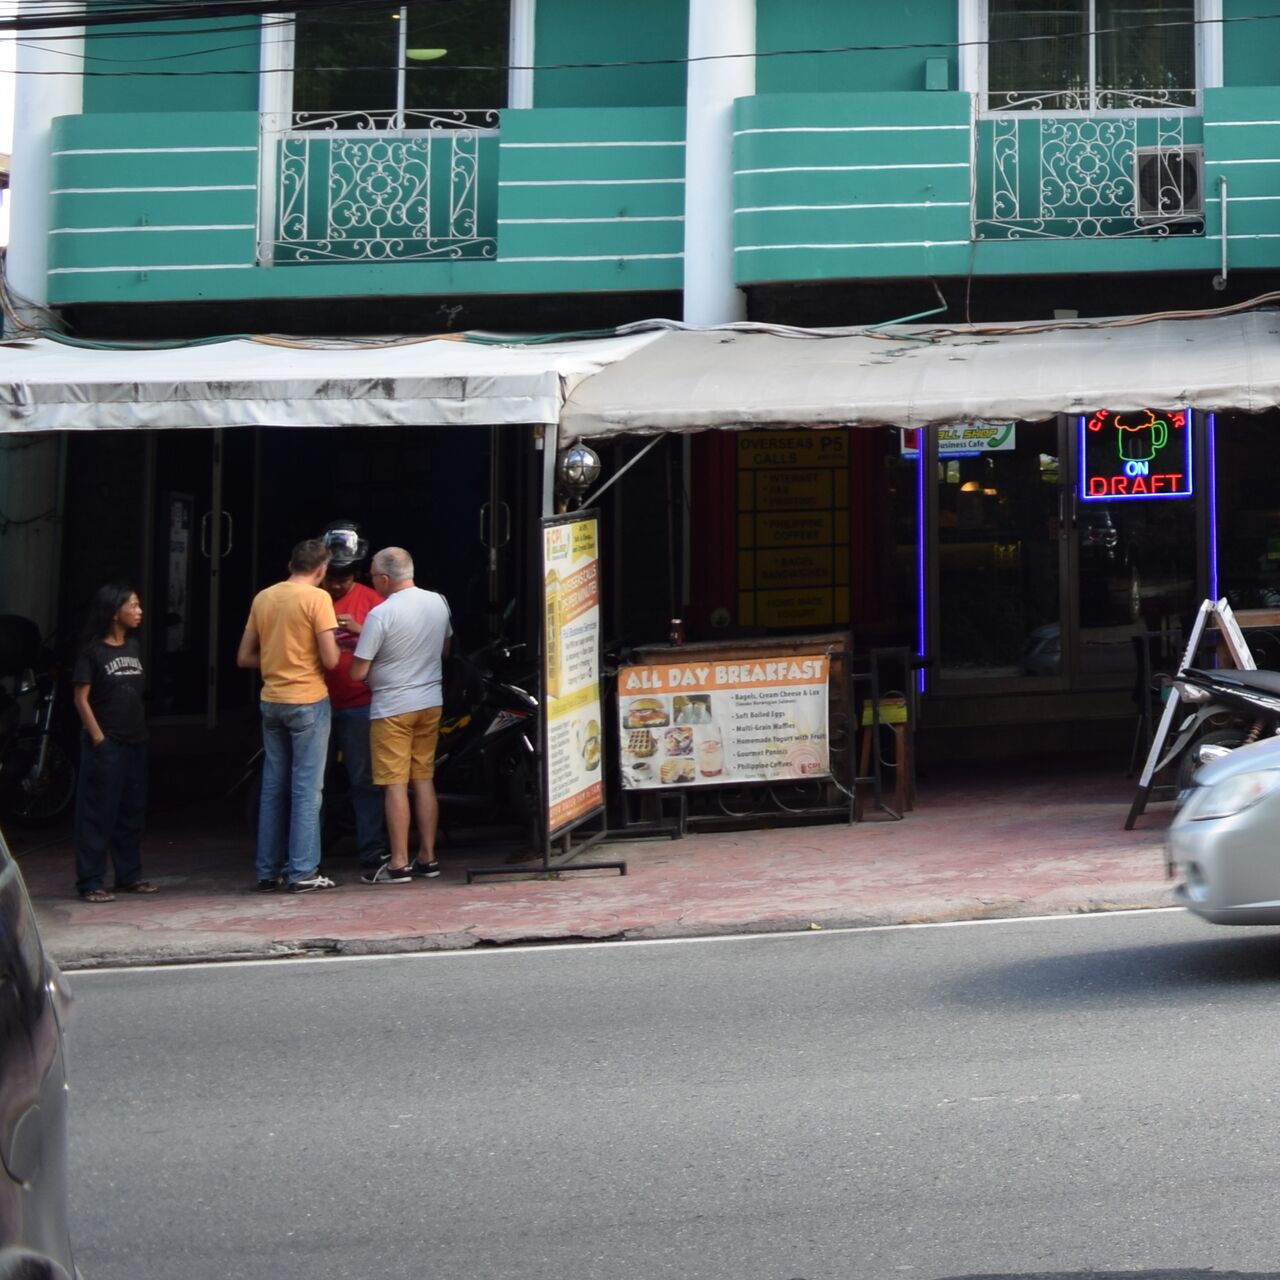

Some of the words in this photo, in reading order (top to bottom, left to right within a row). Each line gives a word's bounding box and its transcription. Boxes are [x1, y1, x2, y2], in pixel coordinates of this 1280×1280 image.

[962, 428, 998, 439] SHOP
[740, 437, 814, 450] OVERSEAS
[938, 441, 967, 449] usiness
[968, 440, 985, 448] Cafe
[753, 453, 798, 465] CALLS
[1126, 461, 1149, 476] ON
[1090, 474, 1183, 496] DRAFT
[626, 670, 662, 689] ALL
[668, 667, 710, 687] DAY
[714, 660, 824, 684] BREAKFAST
[771, 711, 785, 719] Eggs
